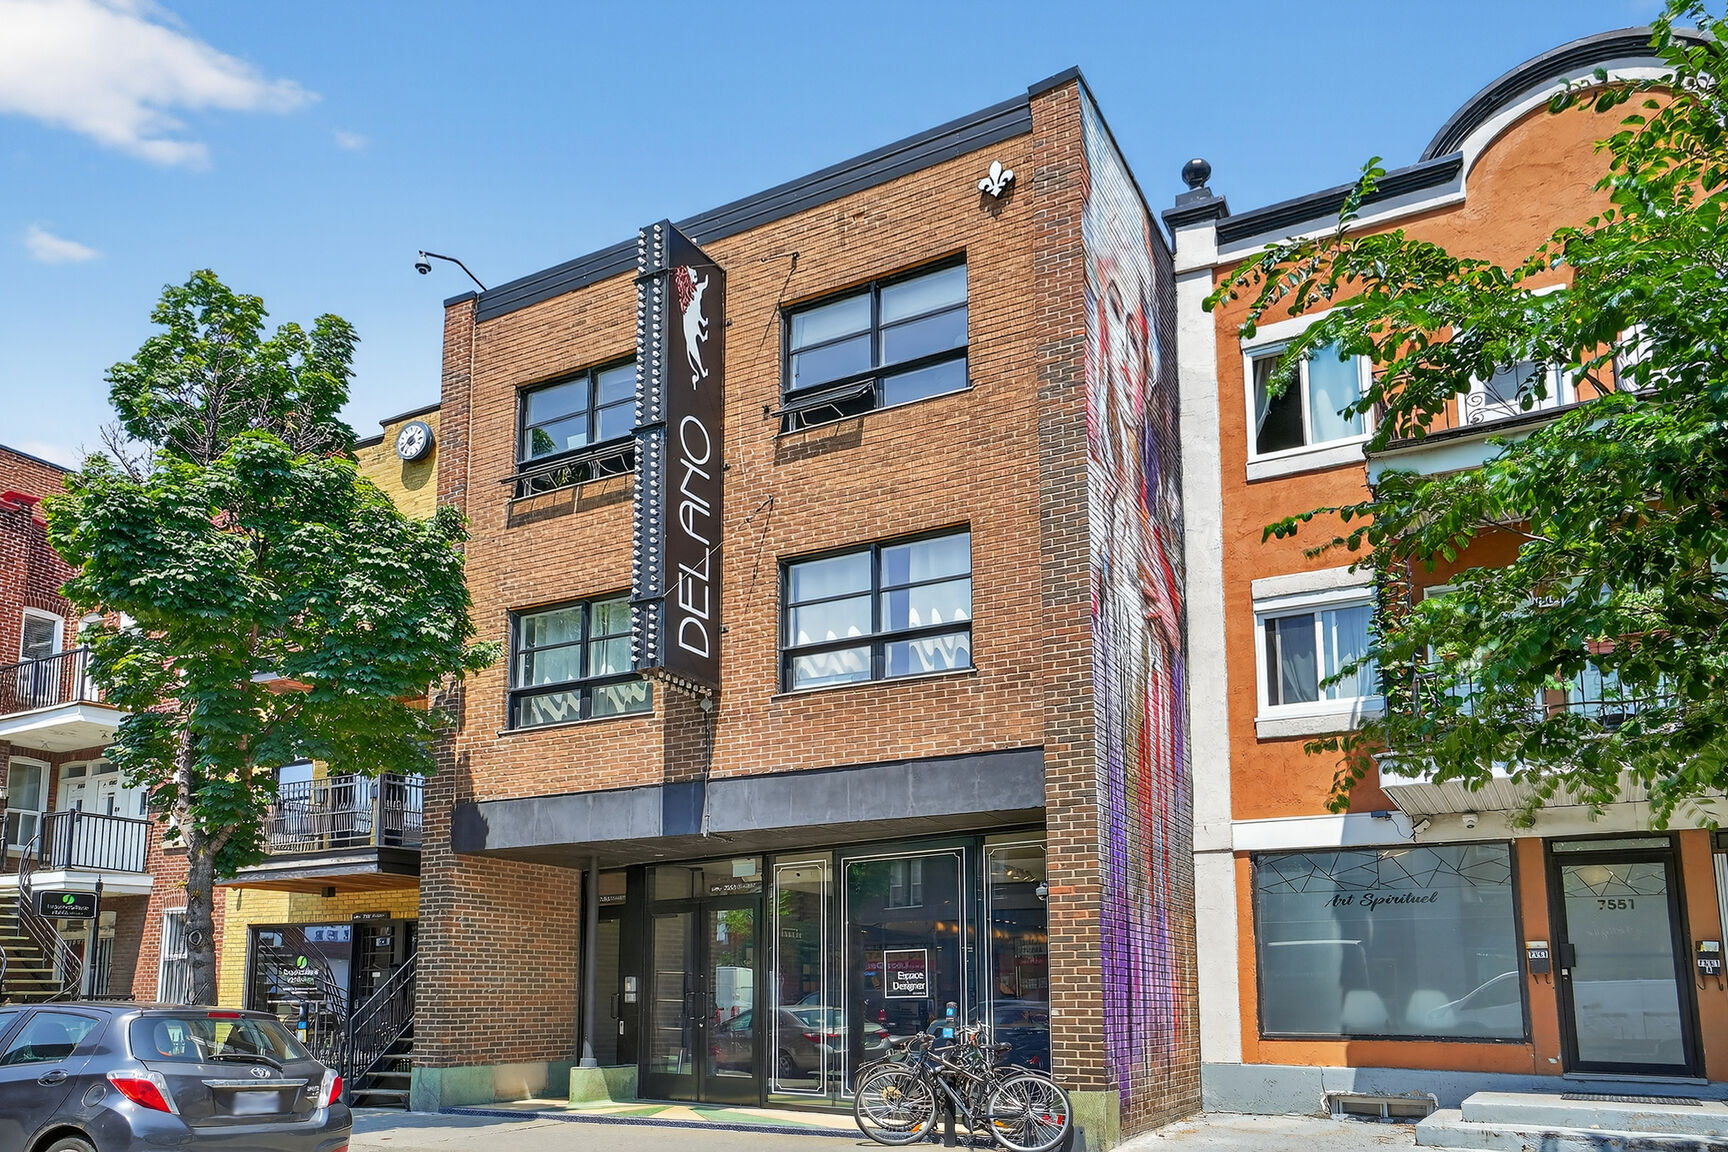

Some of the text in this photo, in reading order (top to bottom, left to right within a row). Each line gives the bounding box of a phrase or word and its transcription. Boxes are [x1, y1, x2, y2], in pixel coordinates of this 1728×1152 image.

[678, 415, 711, 658] DELANO
[1324, 891, 1438, 912] Art Spirituel
[1597, 898, 1635, 910] 7551
